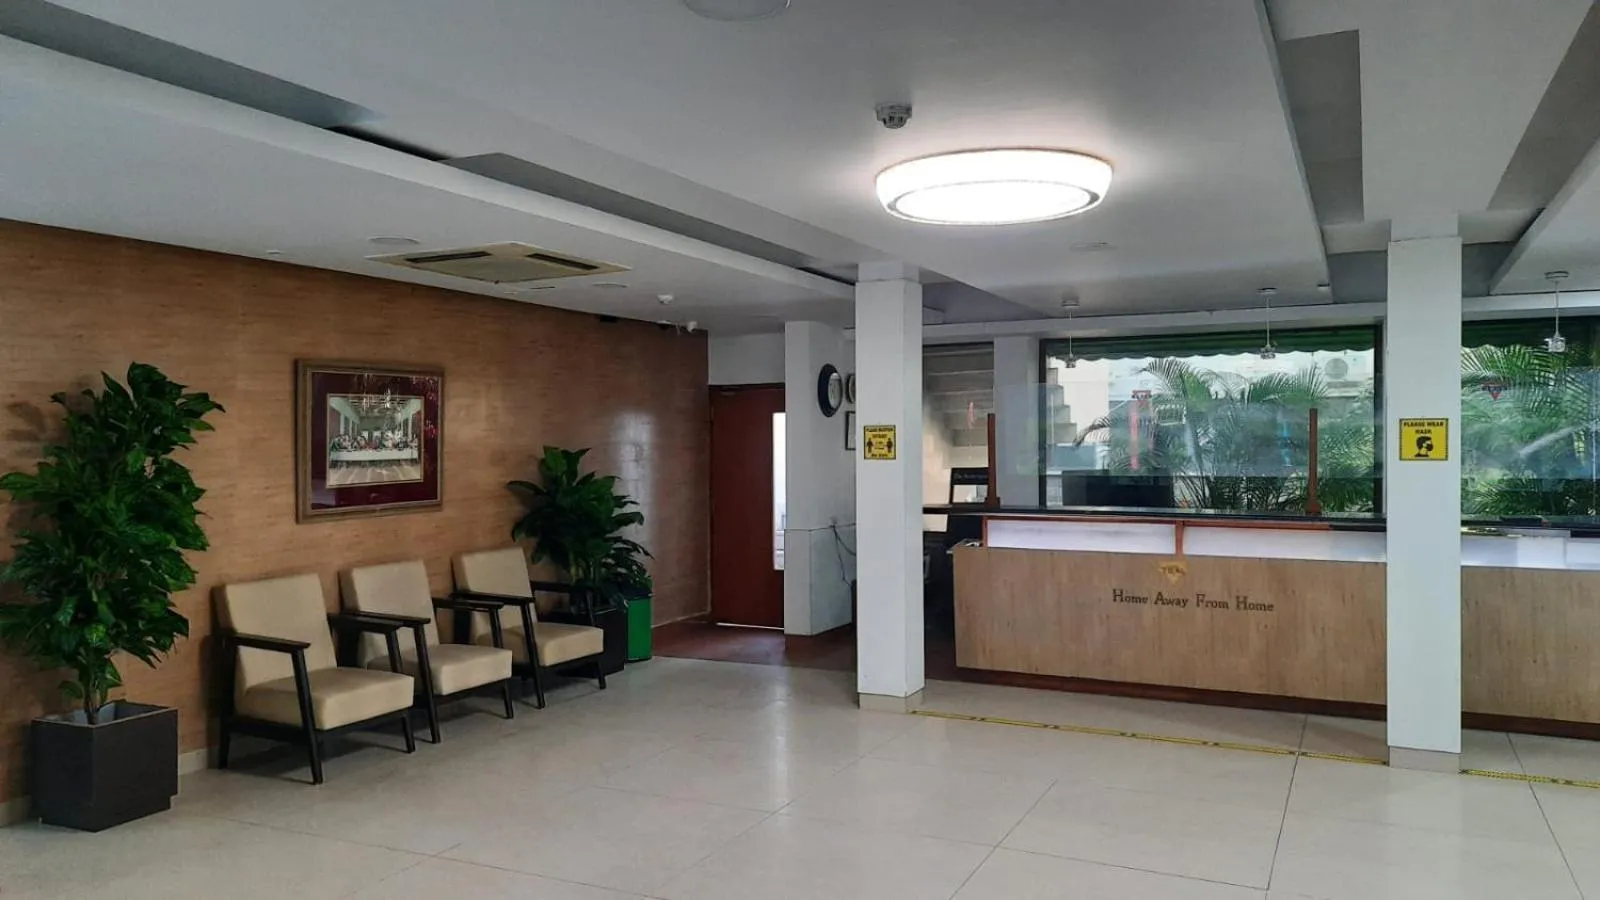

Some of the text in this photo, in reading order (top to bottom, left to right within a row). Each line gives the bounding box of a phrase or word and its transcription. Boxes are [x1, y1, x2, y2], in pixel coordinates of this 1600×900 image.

[1112, 588, 1274, 612] Home Away From Home
